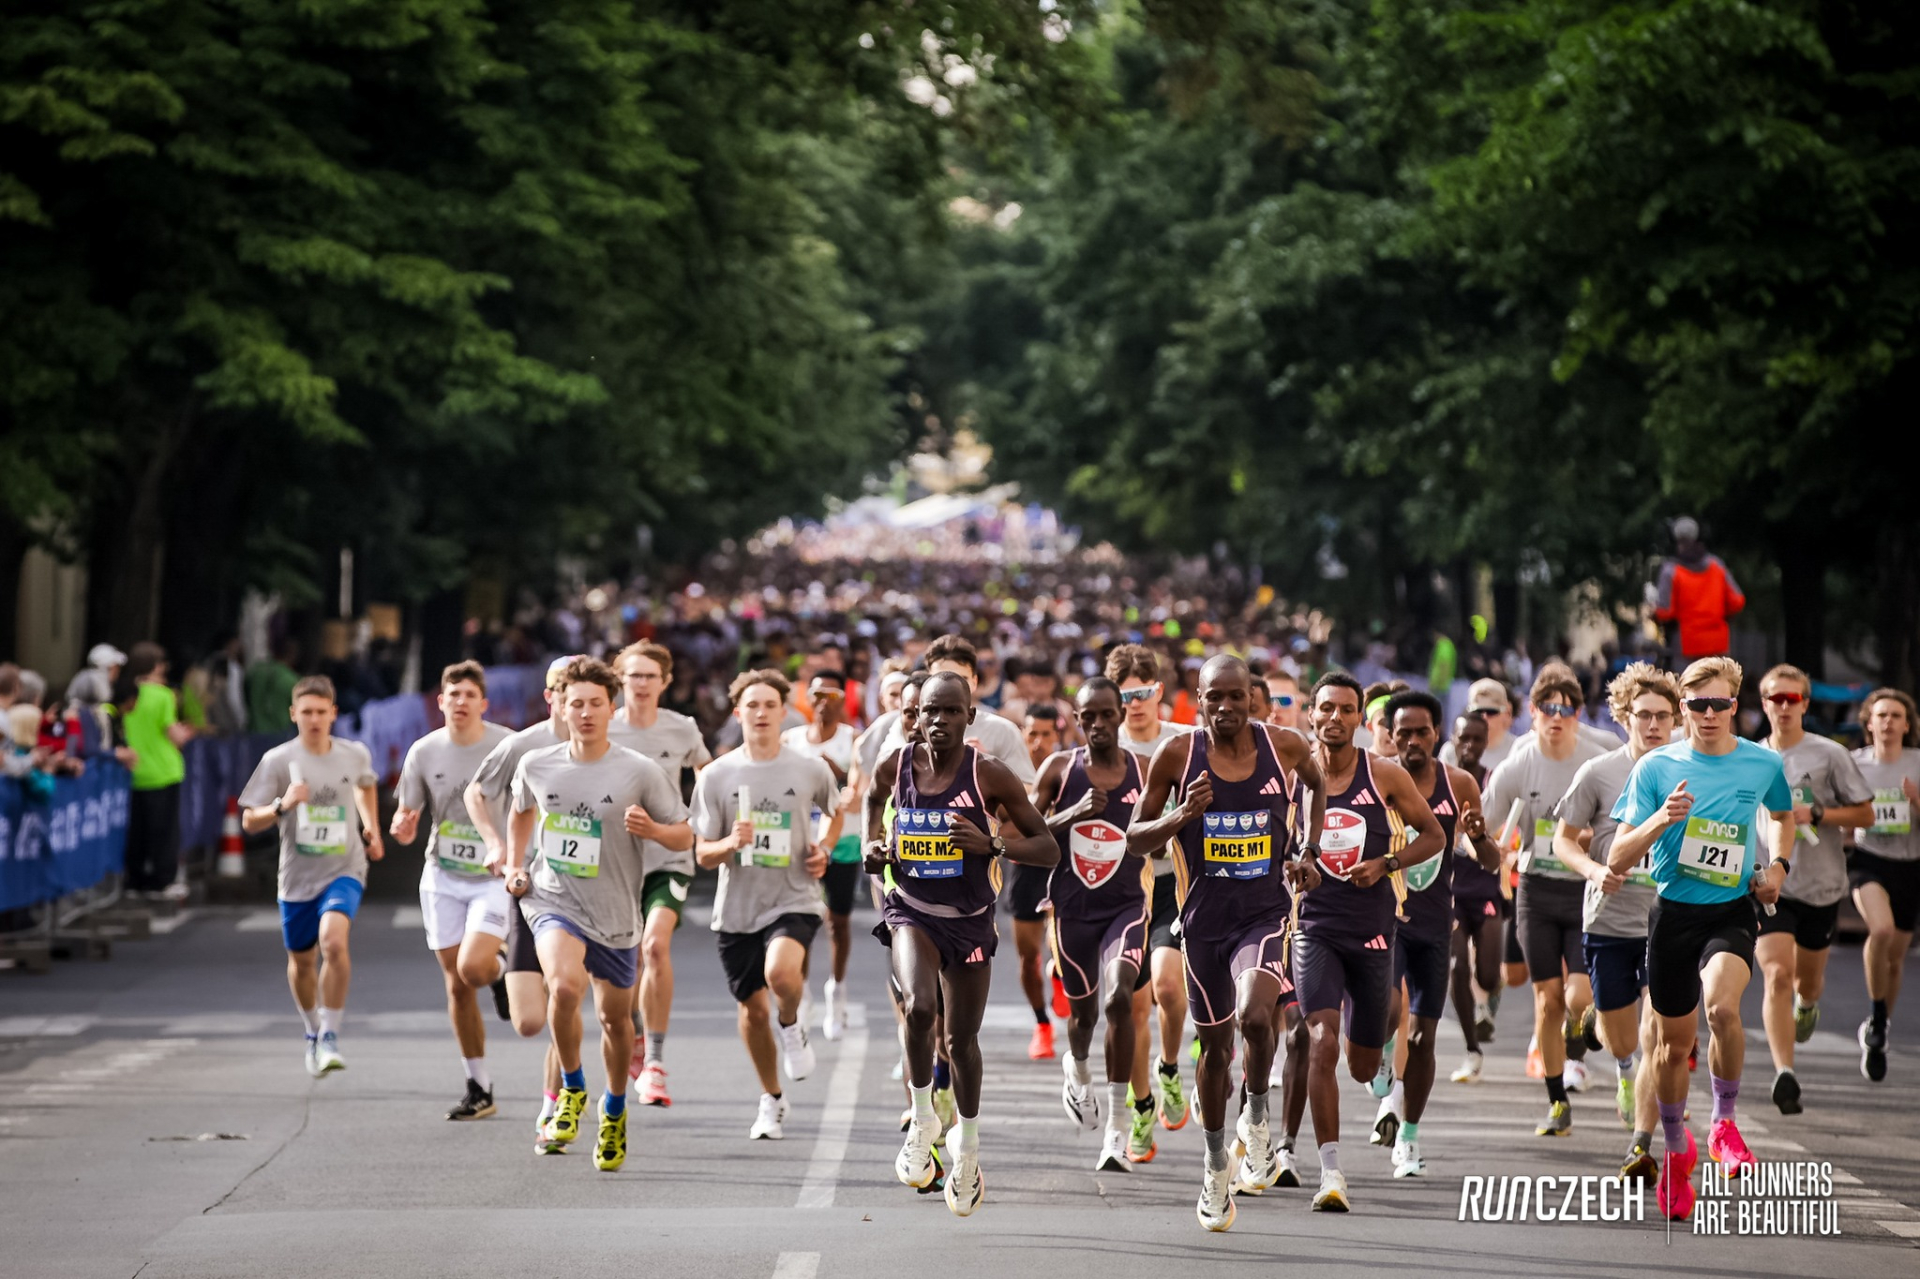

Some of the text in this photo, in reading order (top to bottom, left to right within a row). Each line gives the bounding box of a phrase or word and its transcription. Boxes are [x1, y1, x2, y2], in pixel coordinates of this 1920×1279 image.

[561, 839, 578, 858] J2
[755, 835, 770, 850] J4
[902, 840, 956, 856] PACE M2
[1211, 841, 1264, 858] PACE M1
[1697, 845, 1729, 868] J21
[1087, 868, 1097, 882] 6
[1414, 873, 1422, 886] 1
